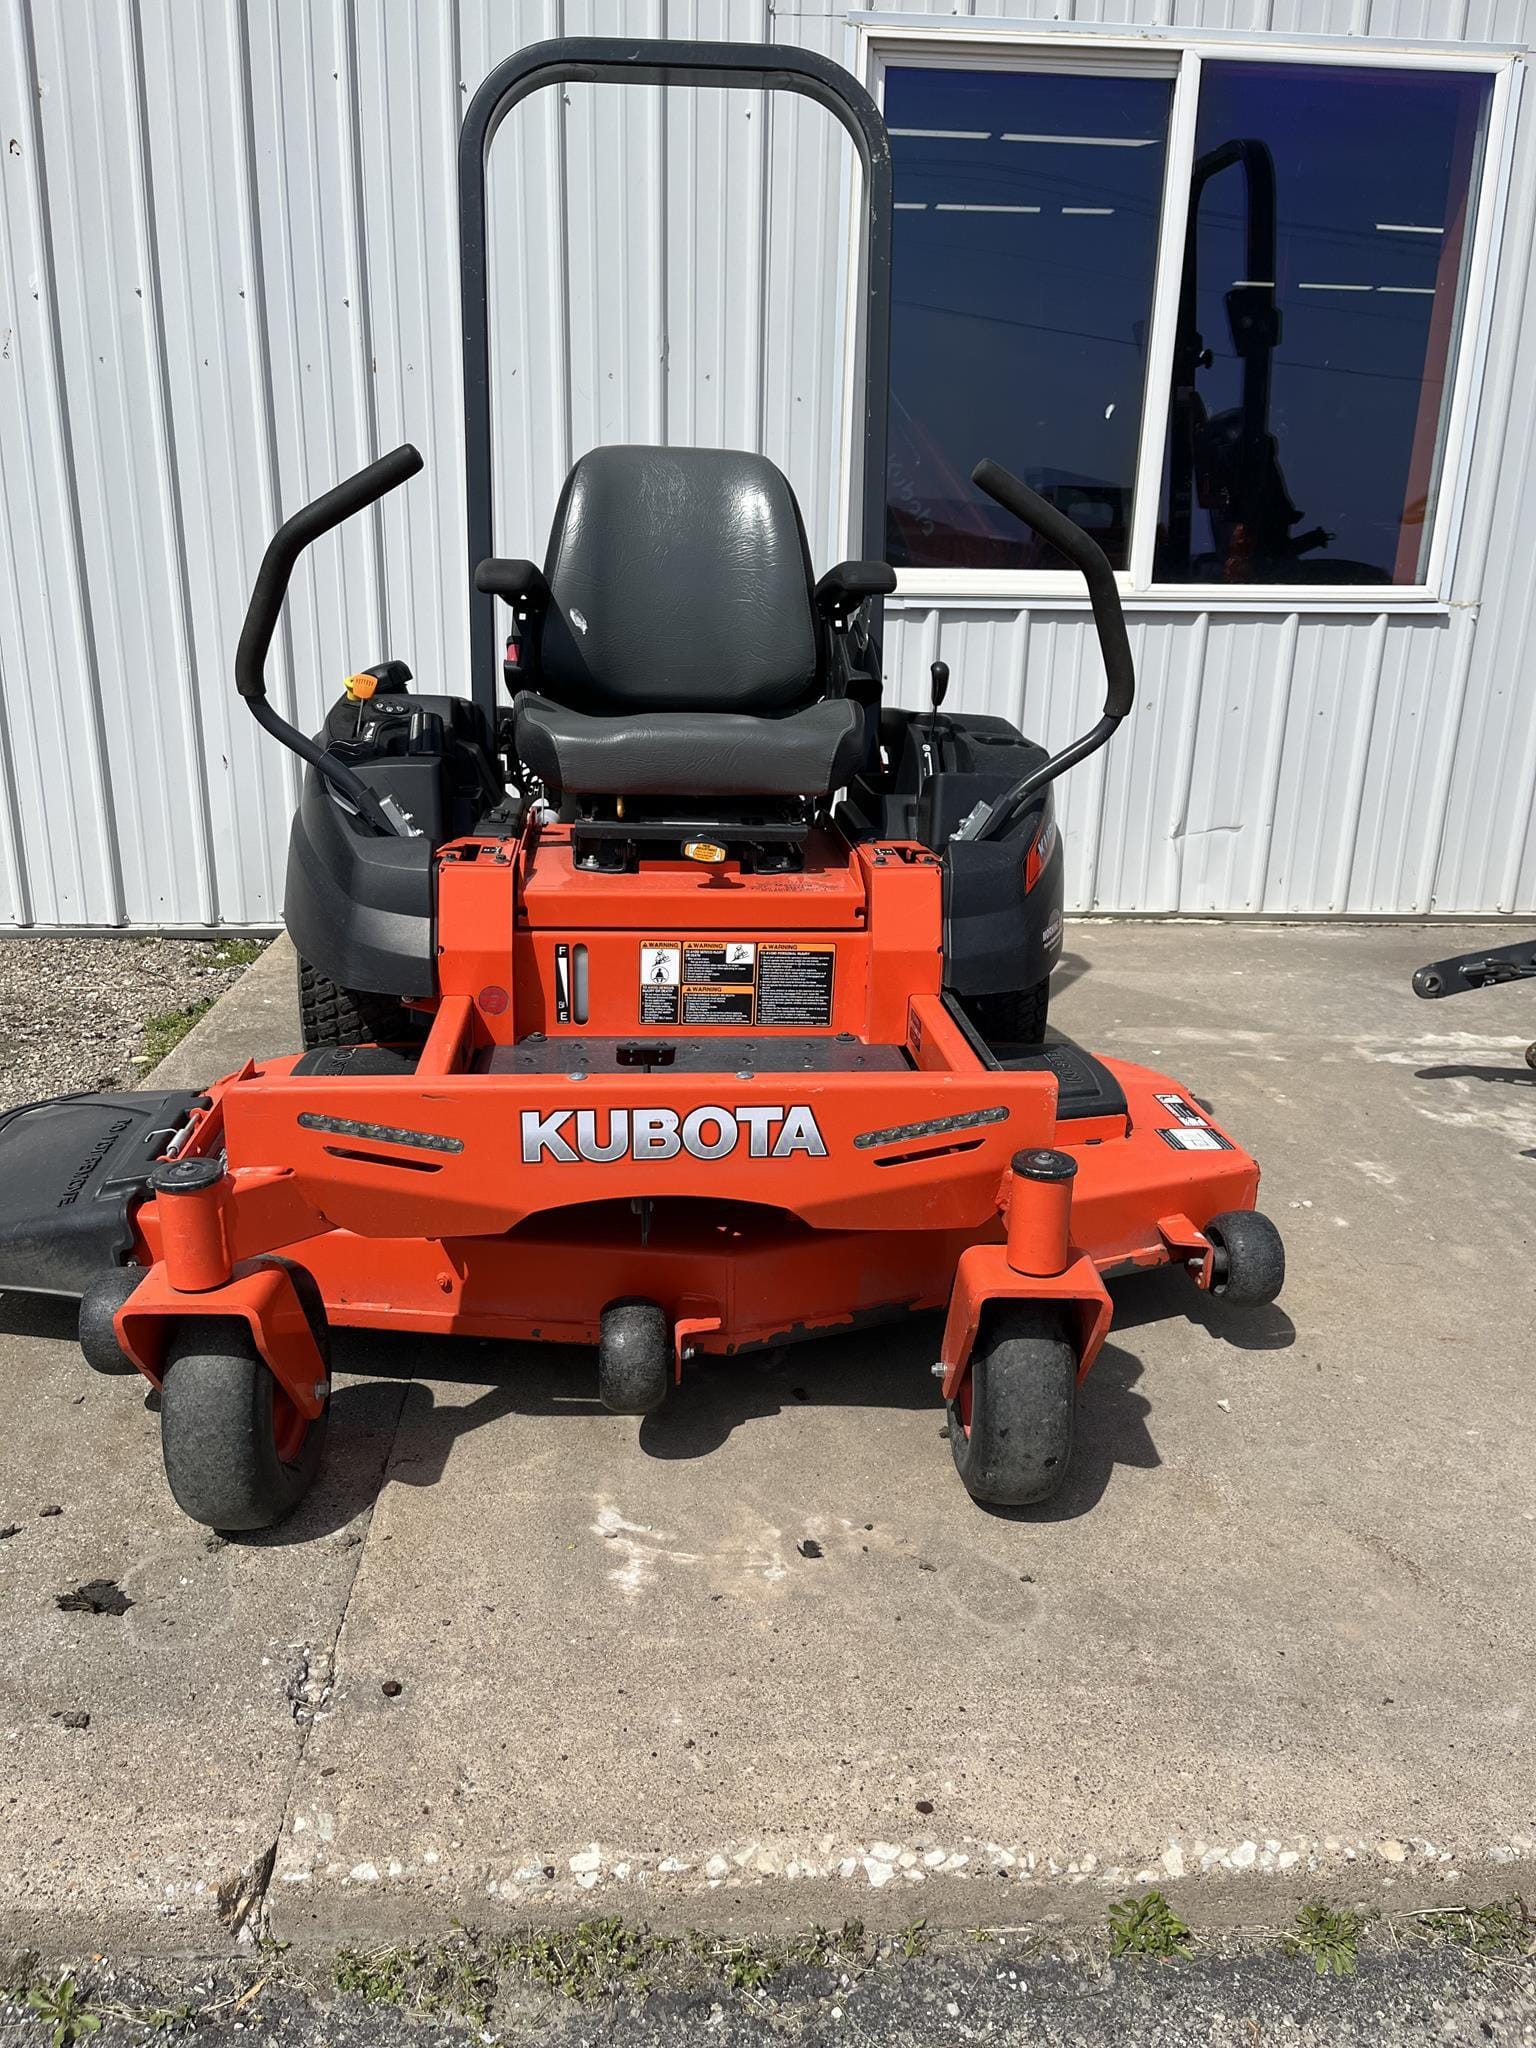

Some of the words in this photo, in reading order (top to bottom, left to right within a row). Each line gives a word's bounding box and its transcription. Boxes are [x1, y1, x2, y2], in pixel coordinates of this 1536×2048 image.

[559, 946, 567, 955] F
[560, 1011, 568, 1020] E
[521, 1104, 829, 1163] KUBOTA
